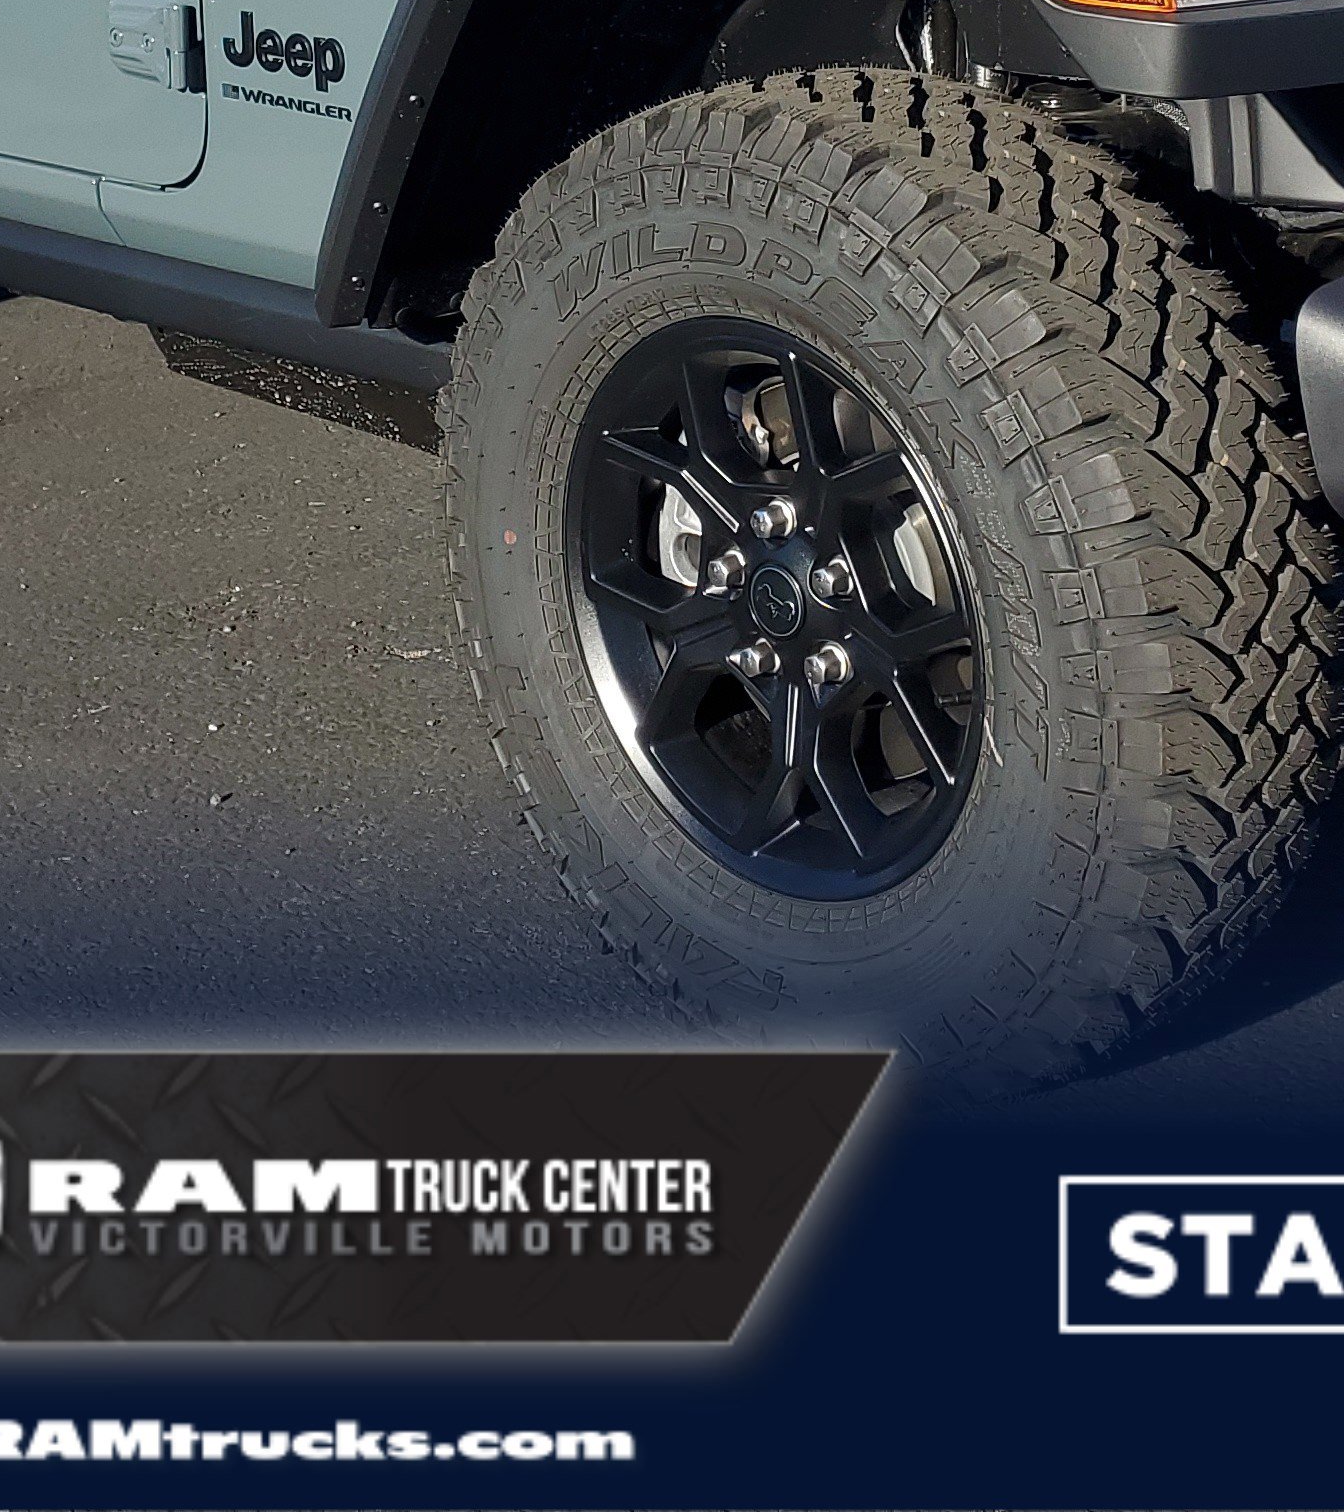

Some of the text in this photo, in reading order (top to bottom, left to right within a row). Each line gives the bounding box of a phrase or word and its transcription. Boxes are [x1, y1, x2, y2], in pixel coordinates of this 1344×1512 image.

[222, 10, 346, 93] Jeep
[240, 86, 354, 123] WRANGLER
[547, 220, 987, 470] WILDPEAK
